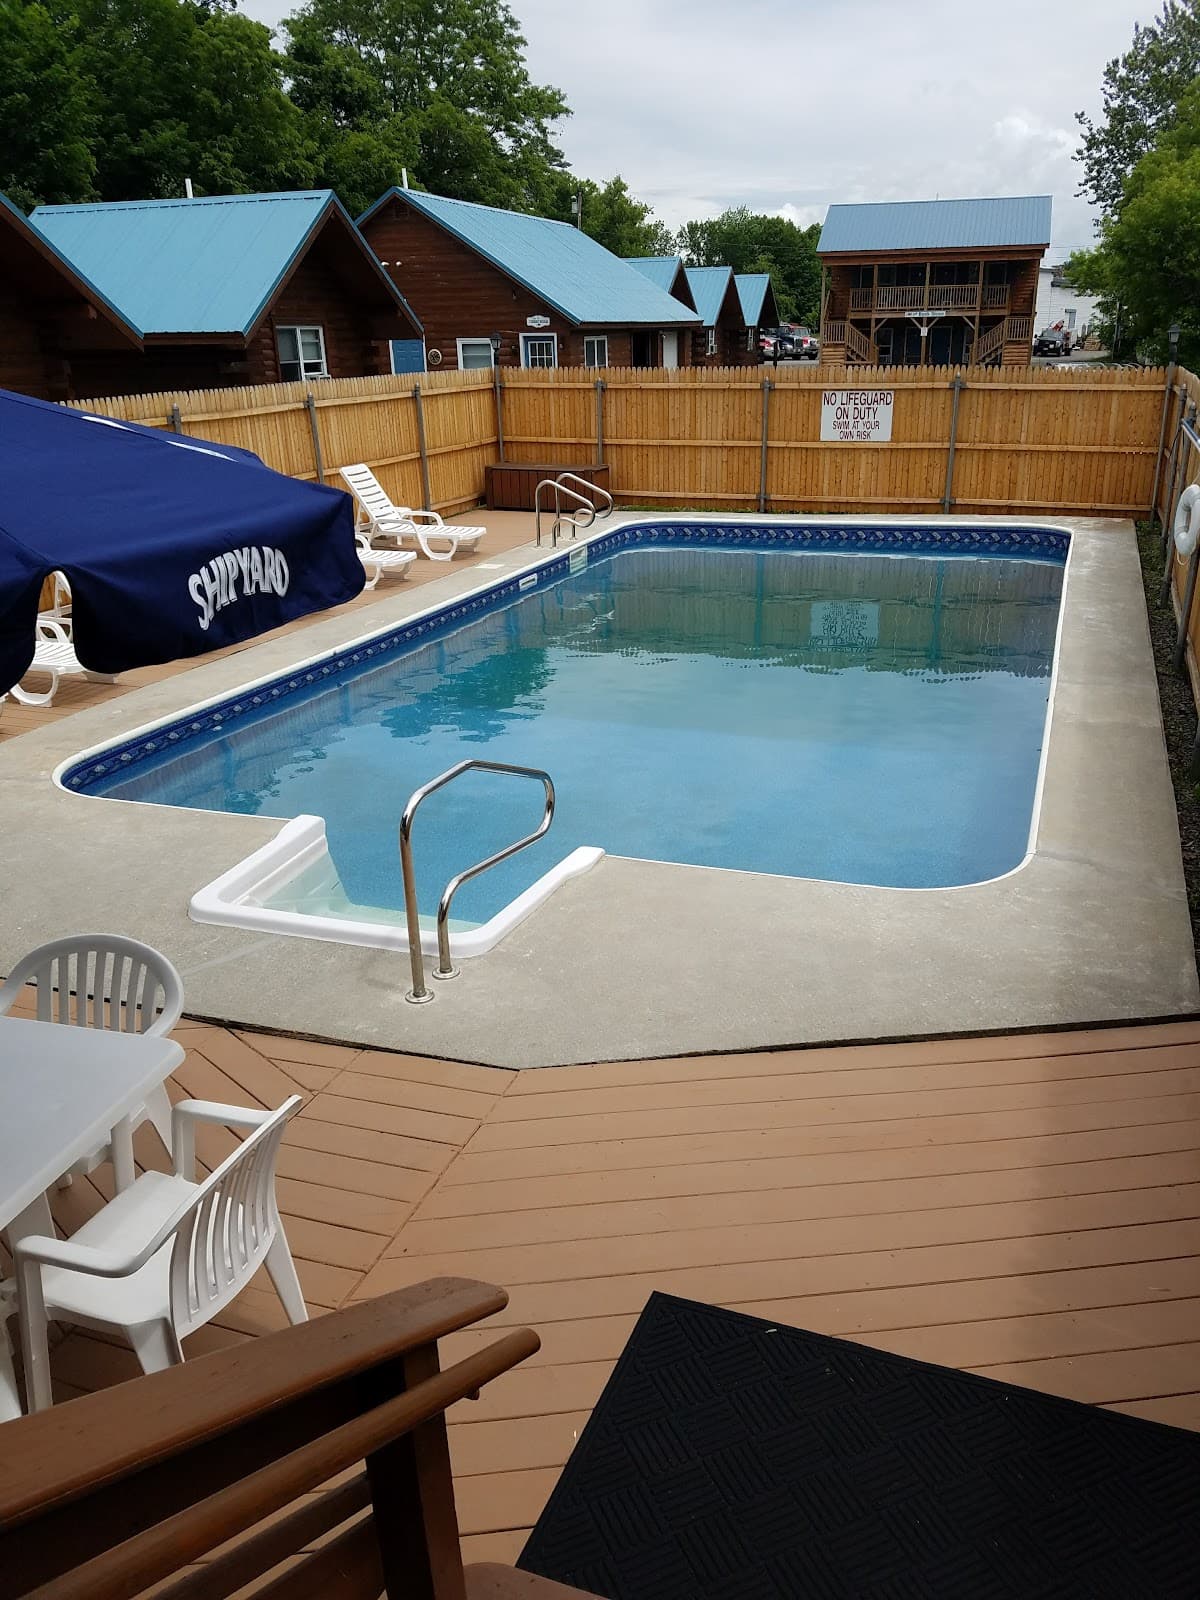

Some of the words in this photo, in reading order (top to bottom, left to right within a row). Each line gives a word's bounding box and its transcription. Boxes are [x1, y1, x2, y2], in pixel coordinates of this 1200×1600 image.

[823, 392, 837, 406] NO
[840, 392, 893, 406] LIFEGUARD
[835, 406, 850, 420] ON
[852, 406, 879, 420] DUTY
[832, 420, 850, 430] SWIM
[852, 420, 860, 430] AT
[862, 420, 880, 430] YOUR
[839, 430, 854, 440] OWN
[856, 430, 872, 440] RISK
[188, 546, 290, 631] SHIPYARD
